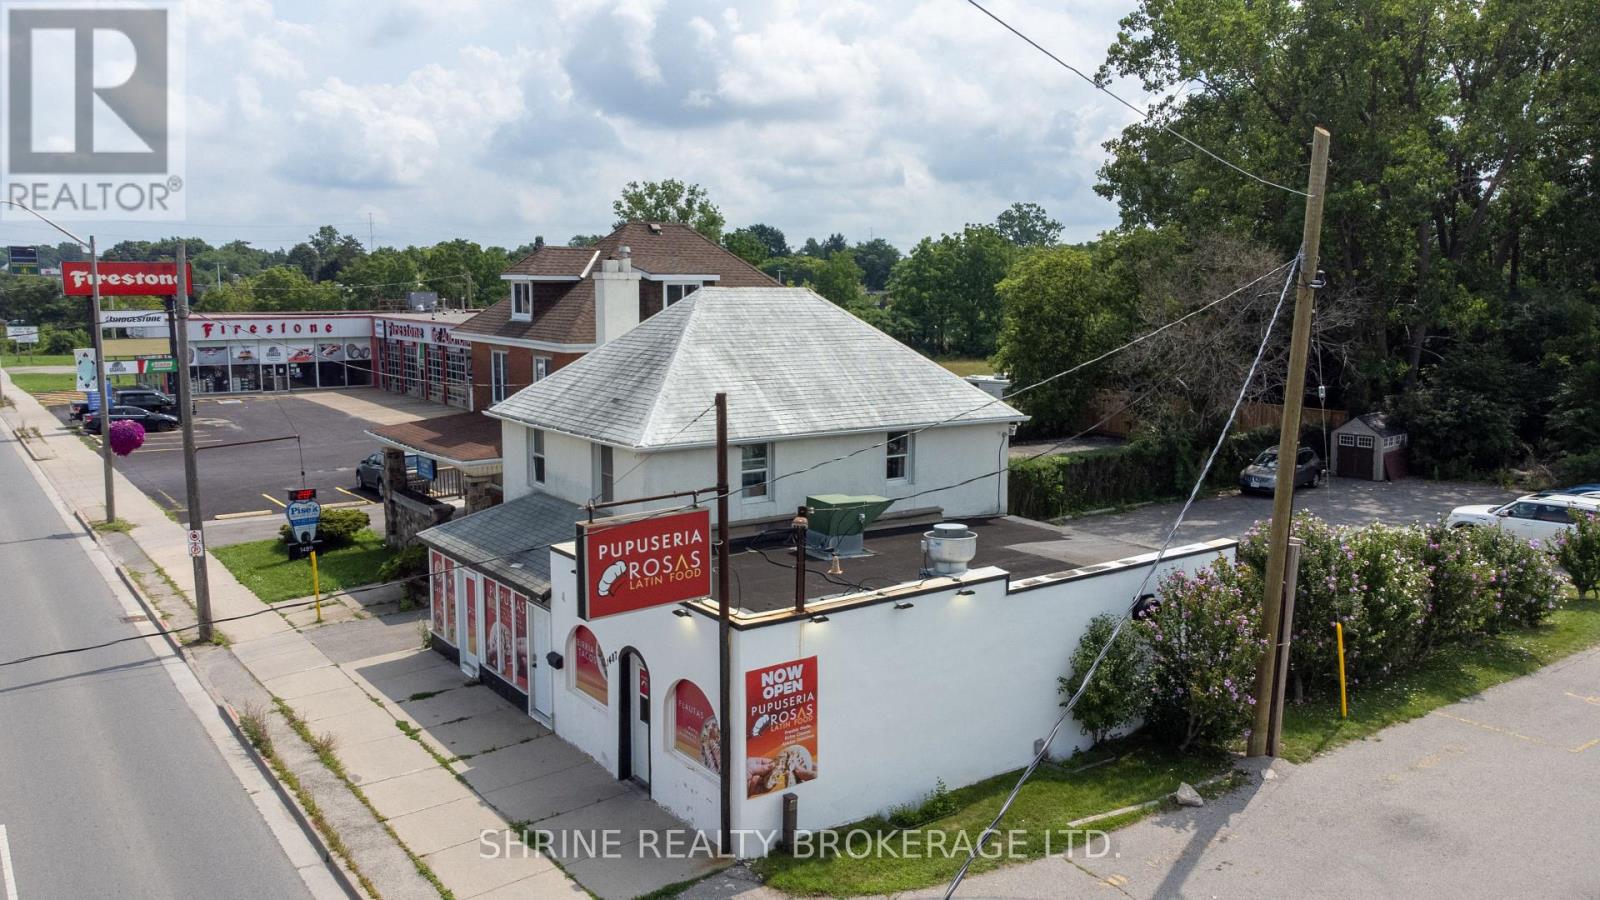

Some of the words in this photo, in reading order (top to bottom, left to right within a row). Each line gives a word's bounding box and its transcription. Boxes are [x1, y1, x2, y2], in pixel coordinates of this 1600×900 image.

[69, 270, 178, 288] Fireston
[202, 322, 333, 338] Firestone
[598, 528, 703, 561] PUPUSERIA
[629, 550, 702, 580] ROSAS
[629, 575, 663, 591] LATIN
[669, 567, 702, 583] FOOD
[761, 663, 804, 688] NOW
[762, 679, 803, 700] OPEN
[751, 691, 815, 717] PUPUSERIA
[770, 703, 813, 726] ROSAS
[770, 721, 791, 732] LATIN
[794, 713, 813, 726] FOOD
